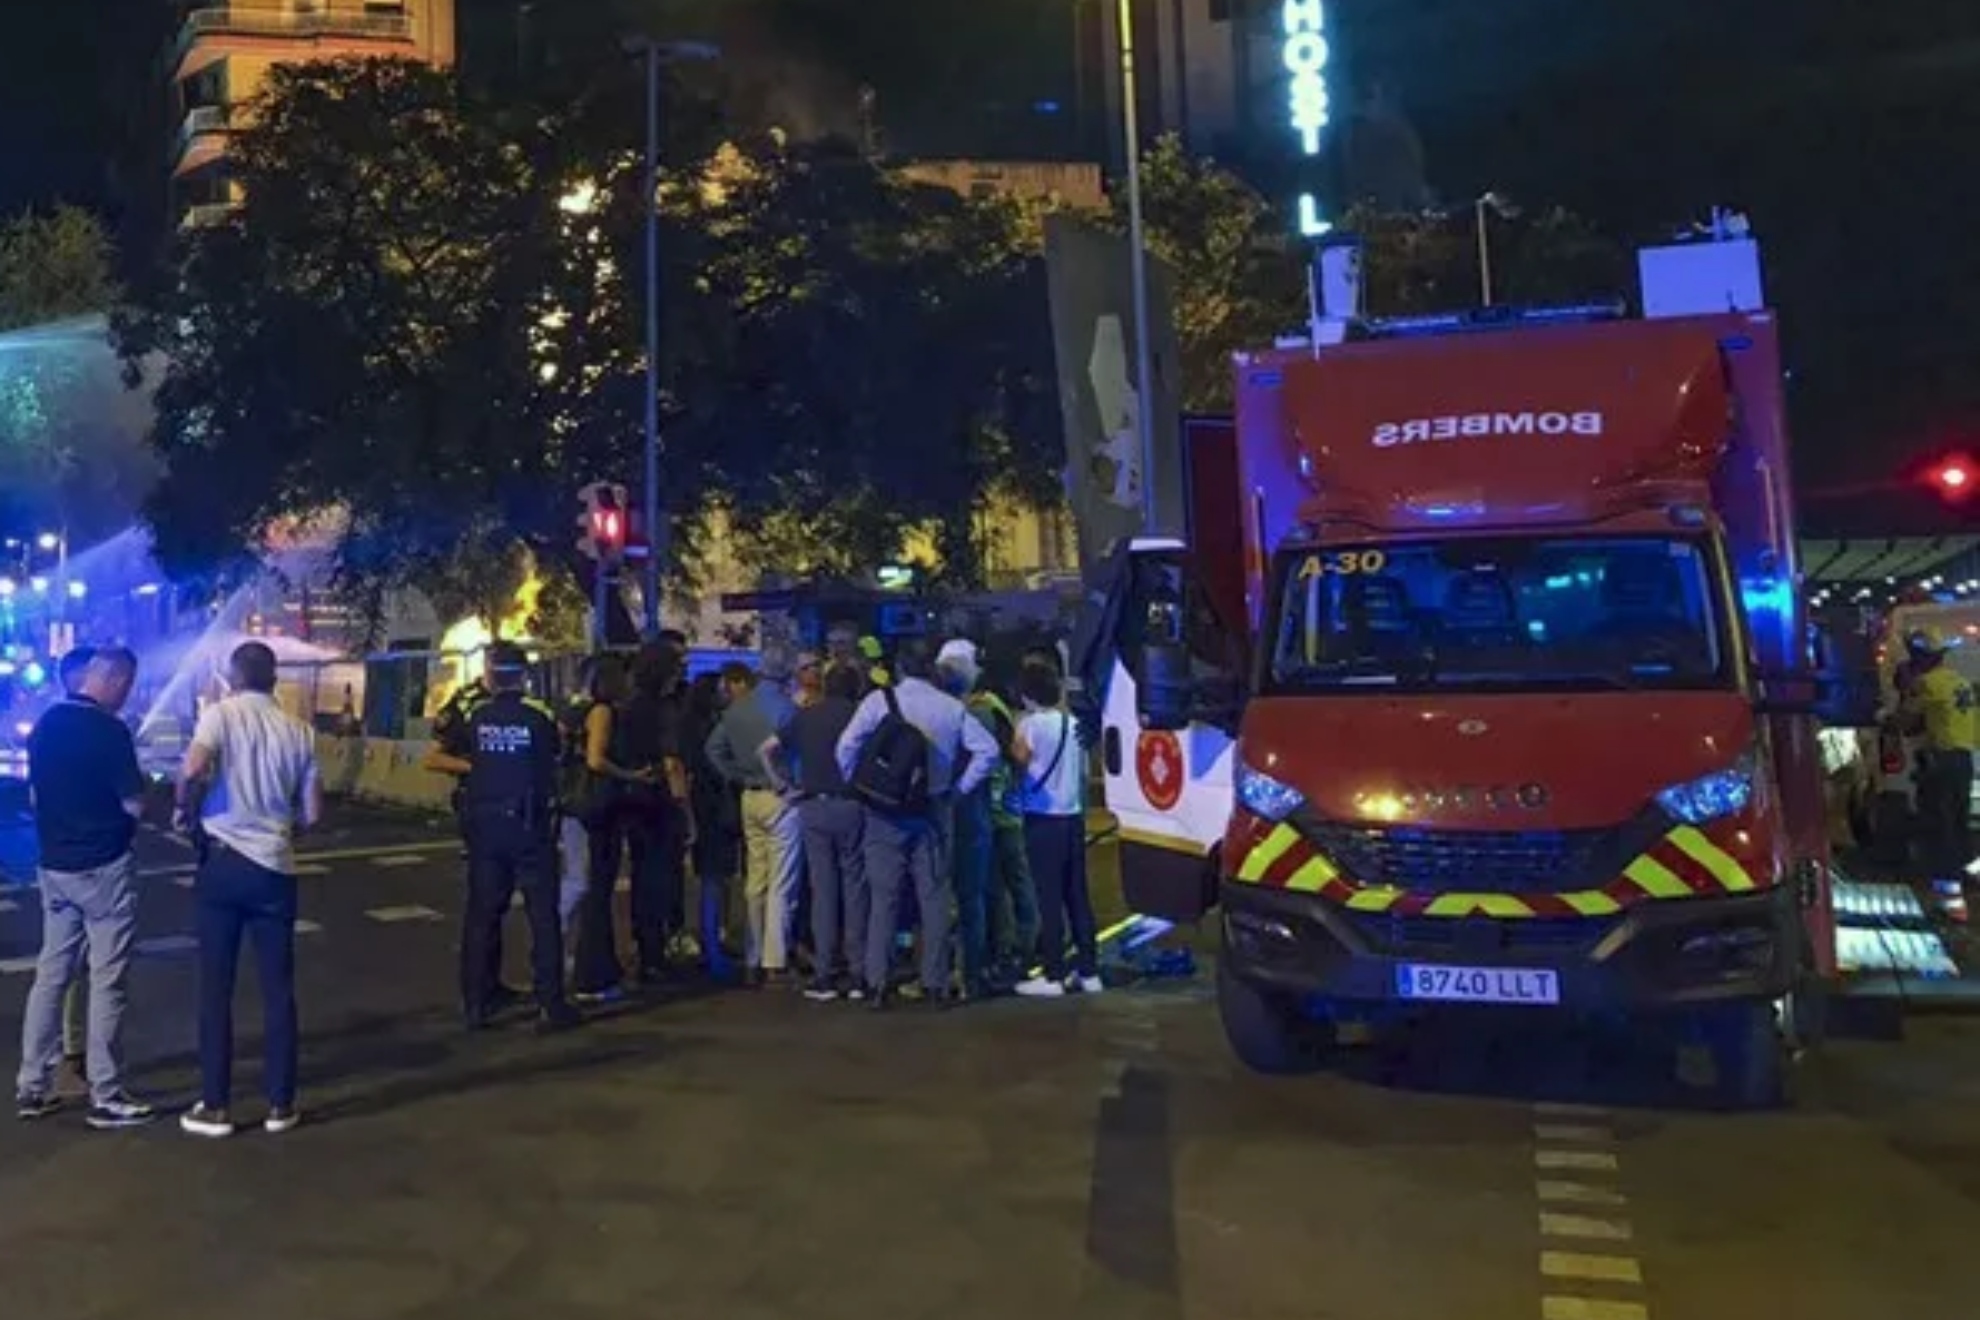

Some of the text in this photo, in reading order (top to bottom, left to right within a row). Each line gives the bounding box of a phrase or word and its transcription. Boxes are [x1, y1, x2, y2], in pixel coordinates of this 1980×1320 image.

[1284, 0, 1333, 236] HOSTL
[1298, 549, 1384, 579] A-30
[1418, 969, 1550, 998] 8740 LLT
